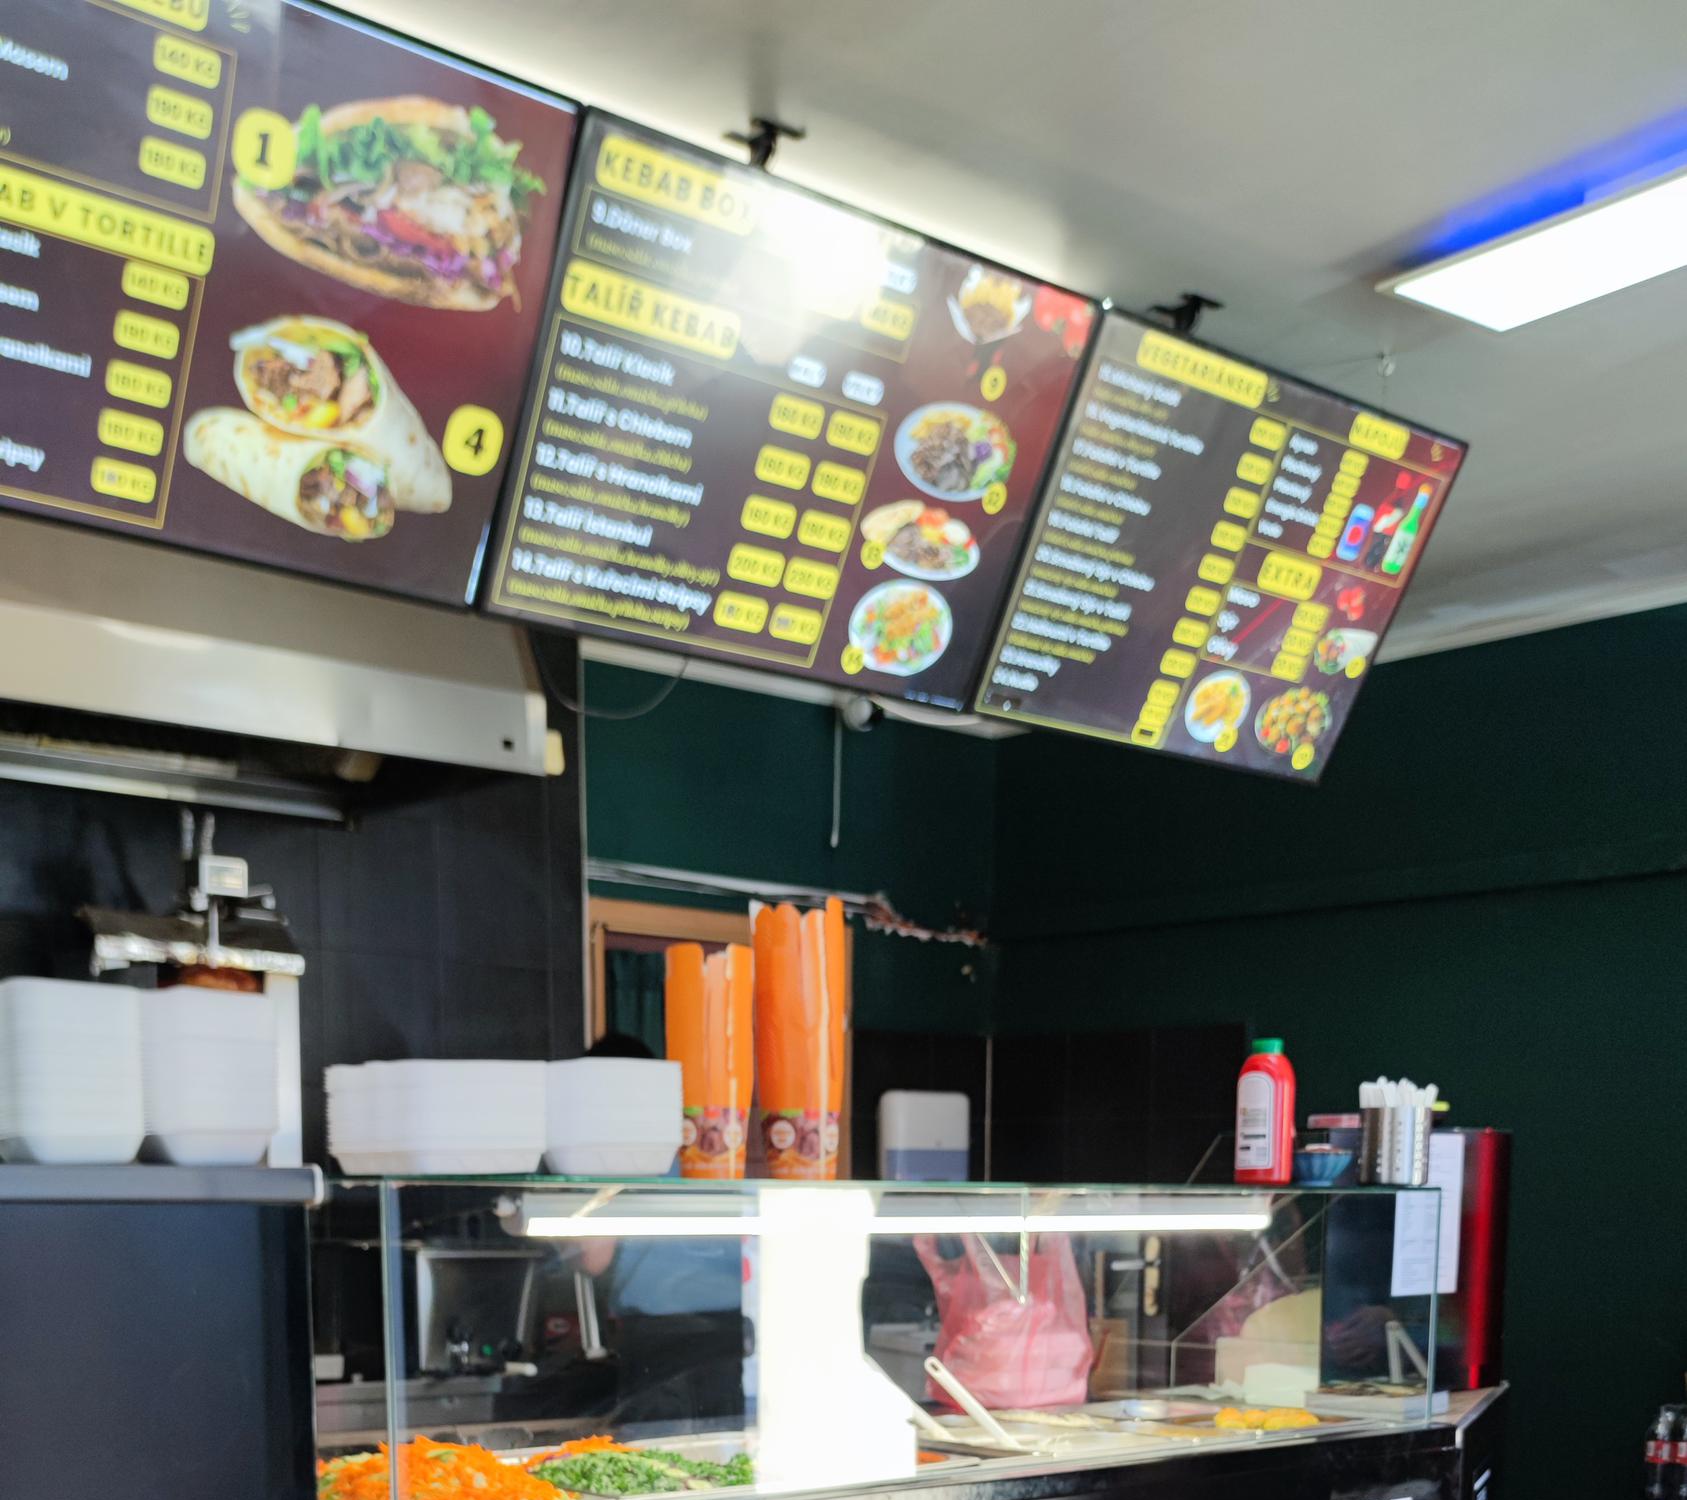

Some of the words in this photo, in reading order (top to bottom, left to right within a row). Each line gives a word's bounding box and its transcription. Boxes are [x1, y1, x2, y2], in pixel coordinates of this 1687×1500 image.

[255, 132, 272, 168] 1
[603, 151, 693, 202] KEBAB
[47, 194, 69, 221] V
[79, 206, 209, 259] TORTILLE
[566, 267, 643, 322] TALÍŘ
[651, 300, 737, 350] KEBAB
[464, 427, 485, 456] 4
